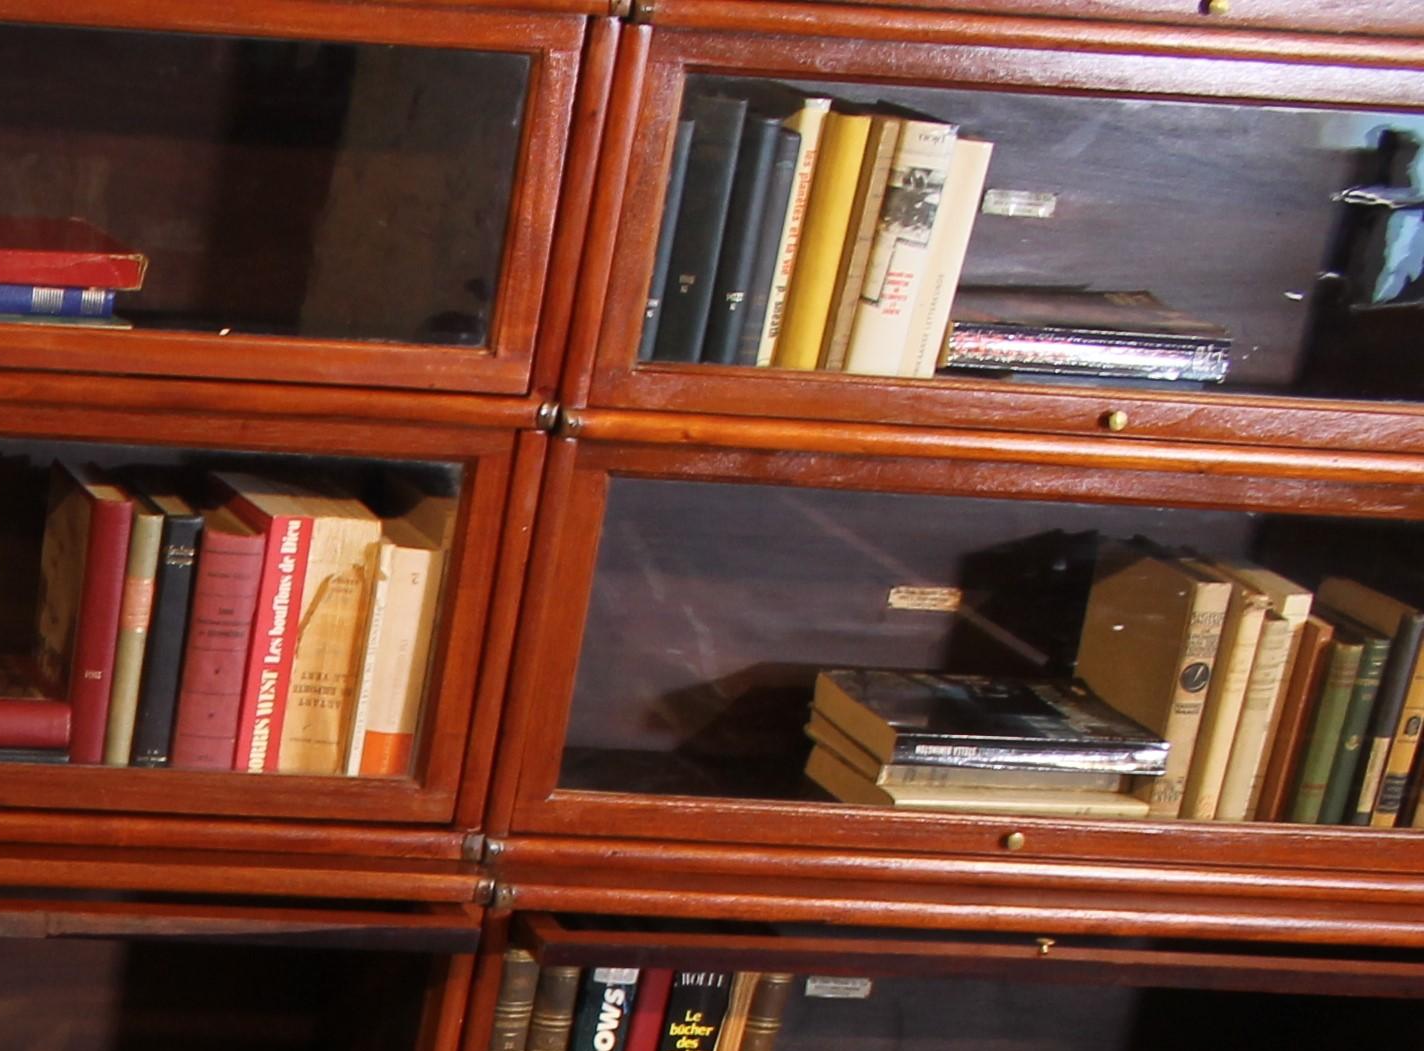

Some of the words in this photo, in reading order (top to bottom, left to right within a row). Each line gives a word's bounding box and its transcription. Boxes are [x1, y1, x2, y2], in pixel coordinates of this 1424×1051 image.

[280, 519, 303, 555] Dieu
[278, 554, 297, 574] de
[268, 577, 294, 637] bouffons
[263, 637, 285, 664] Les
[685, 1009, 703, 1023] Le
[675, 1035, 699, 1050] des
